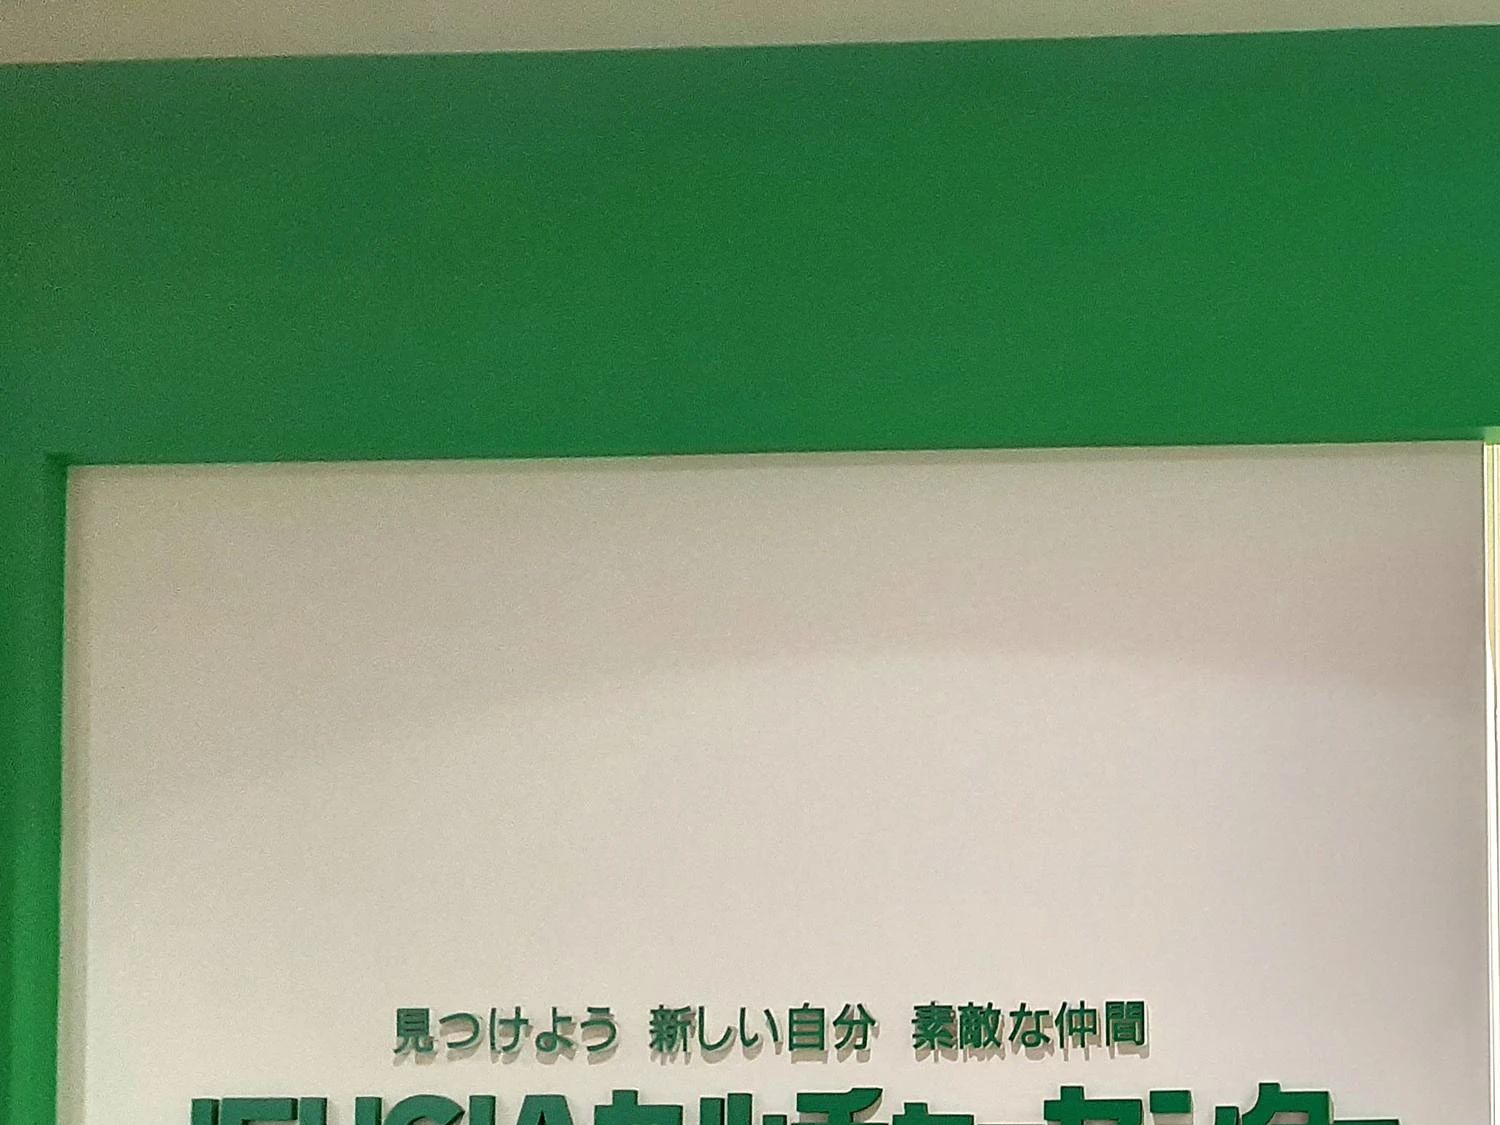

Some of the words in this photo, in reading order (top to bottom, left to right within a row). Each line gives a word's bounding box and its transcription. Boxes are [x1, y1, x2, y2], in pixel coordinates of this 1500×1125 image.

[396, 1007, 618, 1053] 見つけよう
[650, 1005, 875, 1051] 新しい自分
[911, 1002, 1147, 1049] 素敵な仲間
